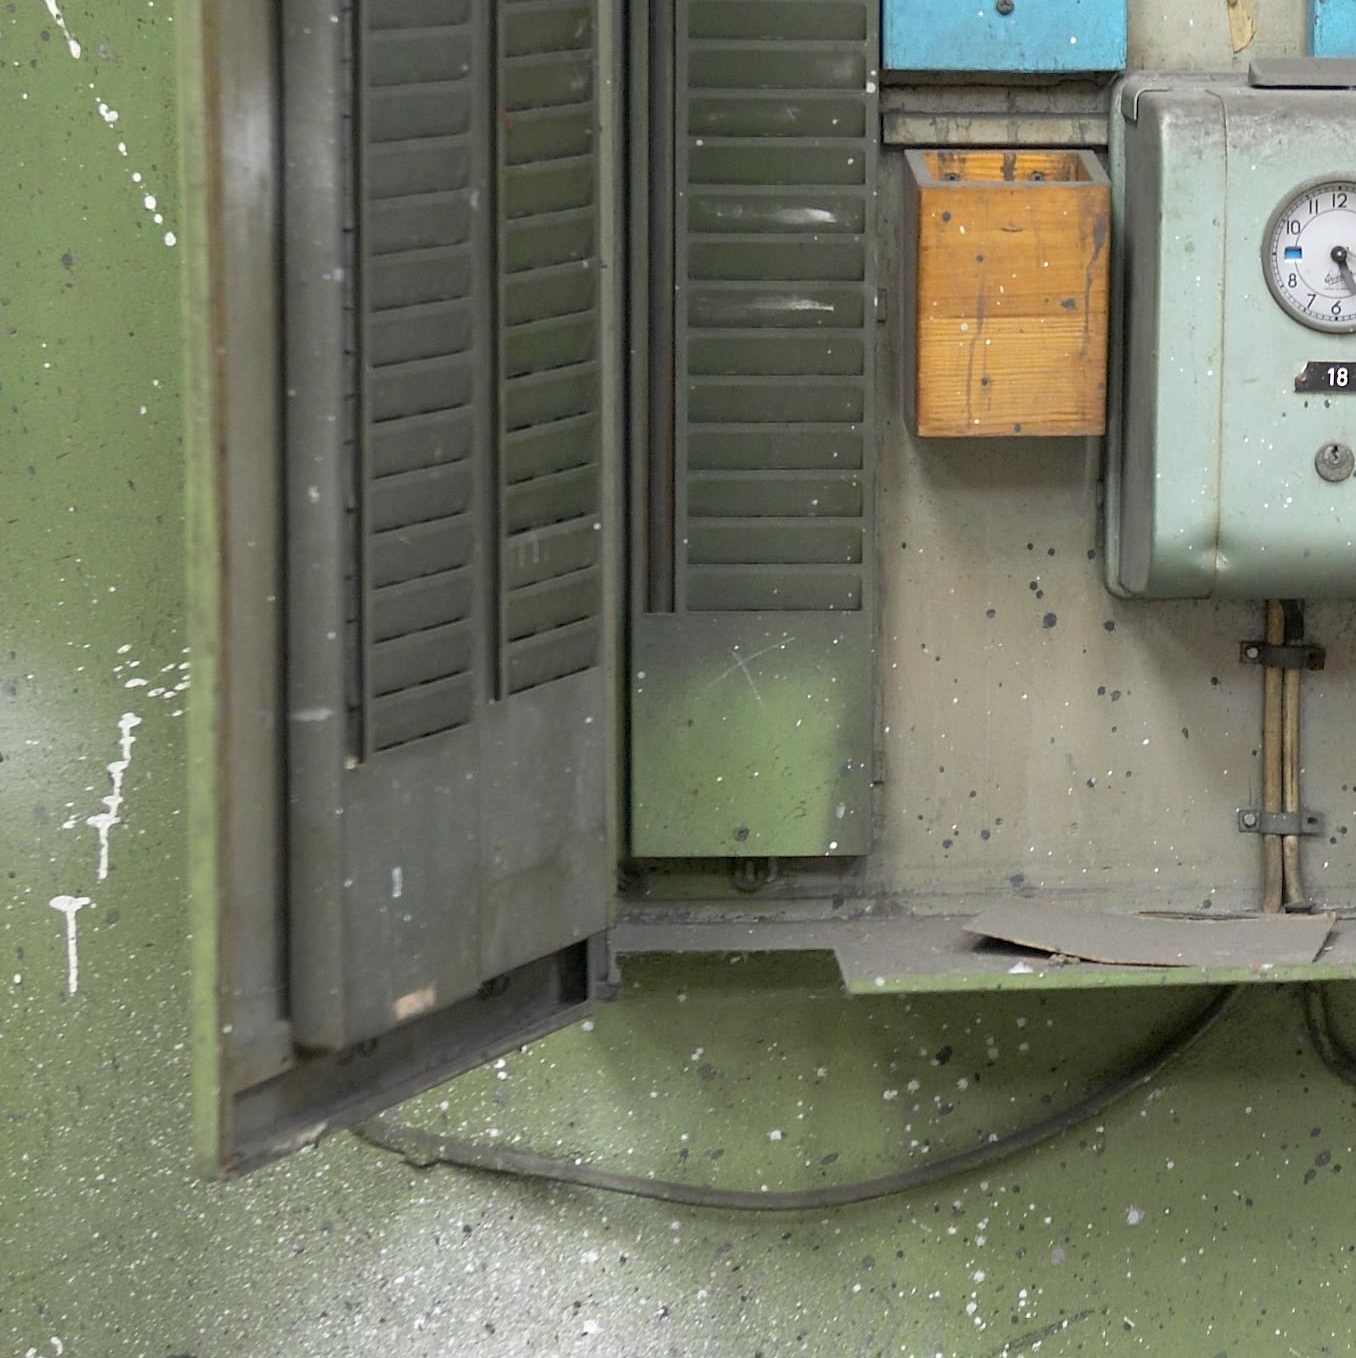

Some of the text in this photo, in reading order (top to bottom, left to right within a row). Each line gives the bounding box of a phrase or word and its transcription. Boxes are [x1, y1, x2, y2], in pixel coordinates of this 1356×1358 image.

[1309, 200, 1318, 214] 11
[1333, 193, 1347, 208] 12
[1287, 220, 1300, 235] 10
[1288, 273, 1297, 288] 8
[1307, 293, 1316, 309] 7
[1331, 300, 1341, 315] 6
[1327, 367, 1348, 387] 18
